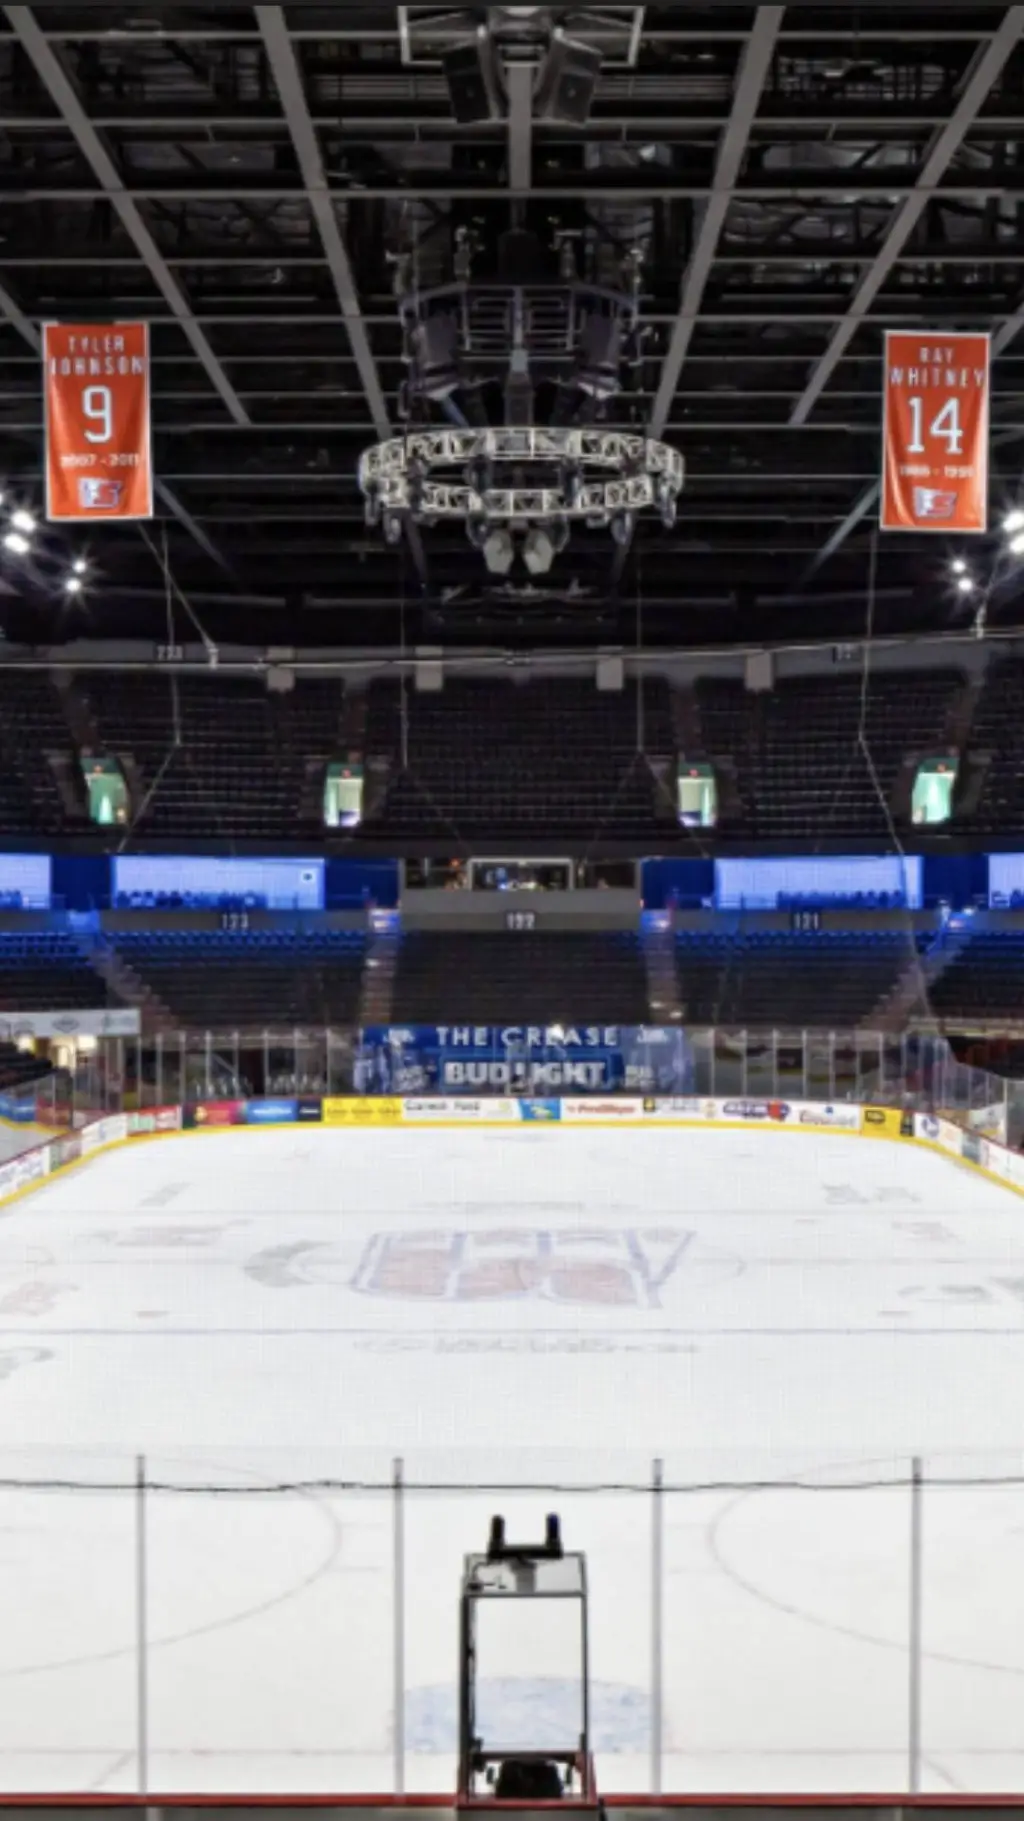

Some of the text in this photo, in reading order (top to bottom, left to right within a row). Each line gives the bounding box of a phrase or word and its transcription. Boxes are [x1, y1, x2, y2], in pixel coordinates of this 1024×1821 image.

[68, 335, 124, 353] TYLER
[920, 347, 955, 364] RAY
[50, 356, 142, 376] JOHNSON
[891, 367, 985, 387] WHITNEY
[82, 385, 113, 443] 9
[906, 396, 964, 455] 14
[793, 911, 819, 930] 121
[436, 1026, 618, 1047] THE CREASE
[444, 1062, 510, 1085] BUD
